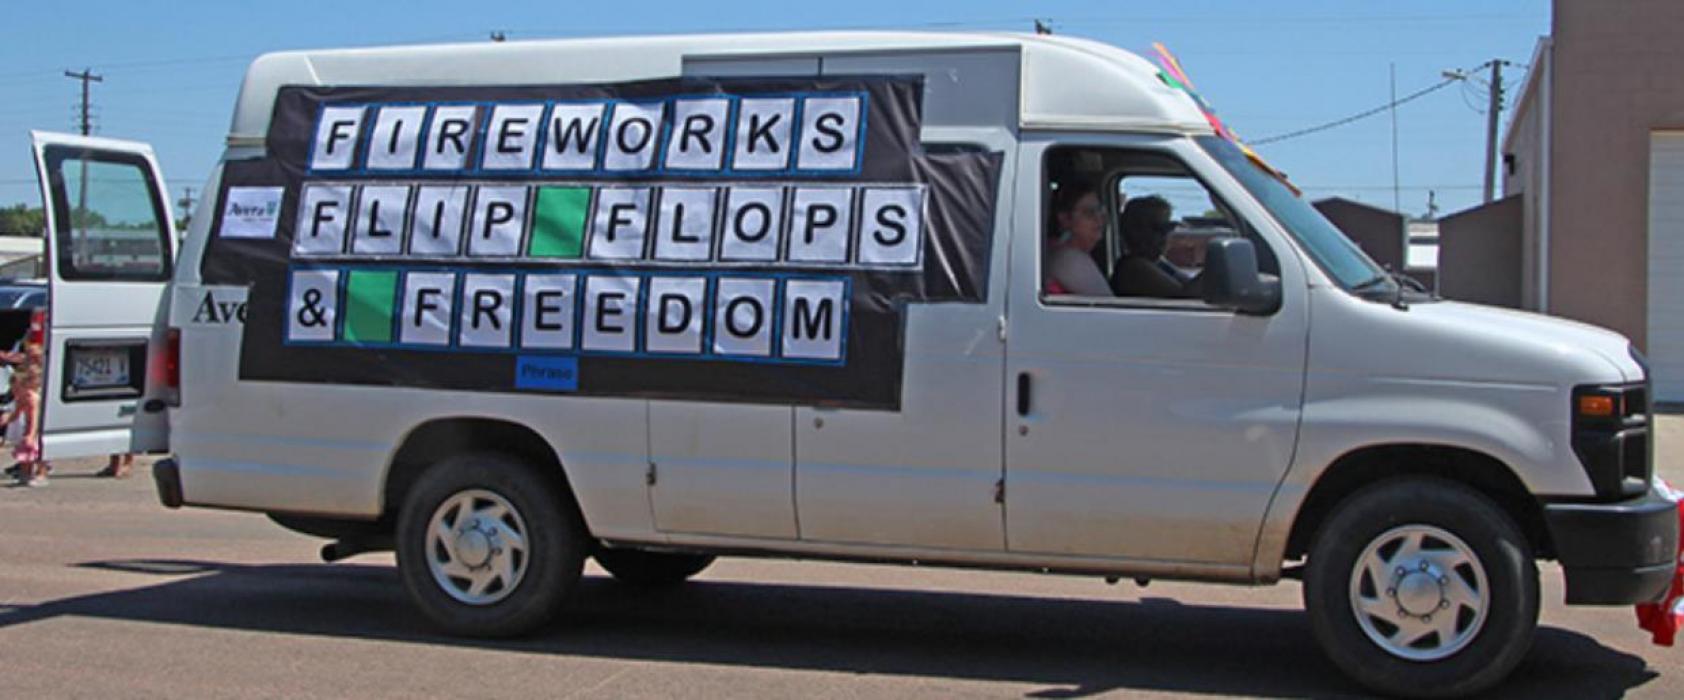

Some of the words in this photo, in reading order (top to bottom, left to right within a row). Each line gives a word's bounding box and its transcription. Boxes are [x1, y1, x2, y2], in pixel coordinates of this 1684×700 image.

[325, 112, 846, 156] FIREWORKS
[310, 200, 515, 240] FLIP
[605, 202, 907, 248] FLOPS
[296, 287, 328, 328] &
[412, 288, 835, 342] FREEDOM
[521, 363, 572, 381] Phrase
